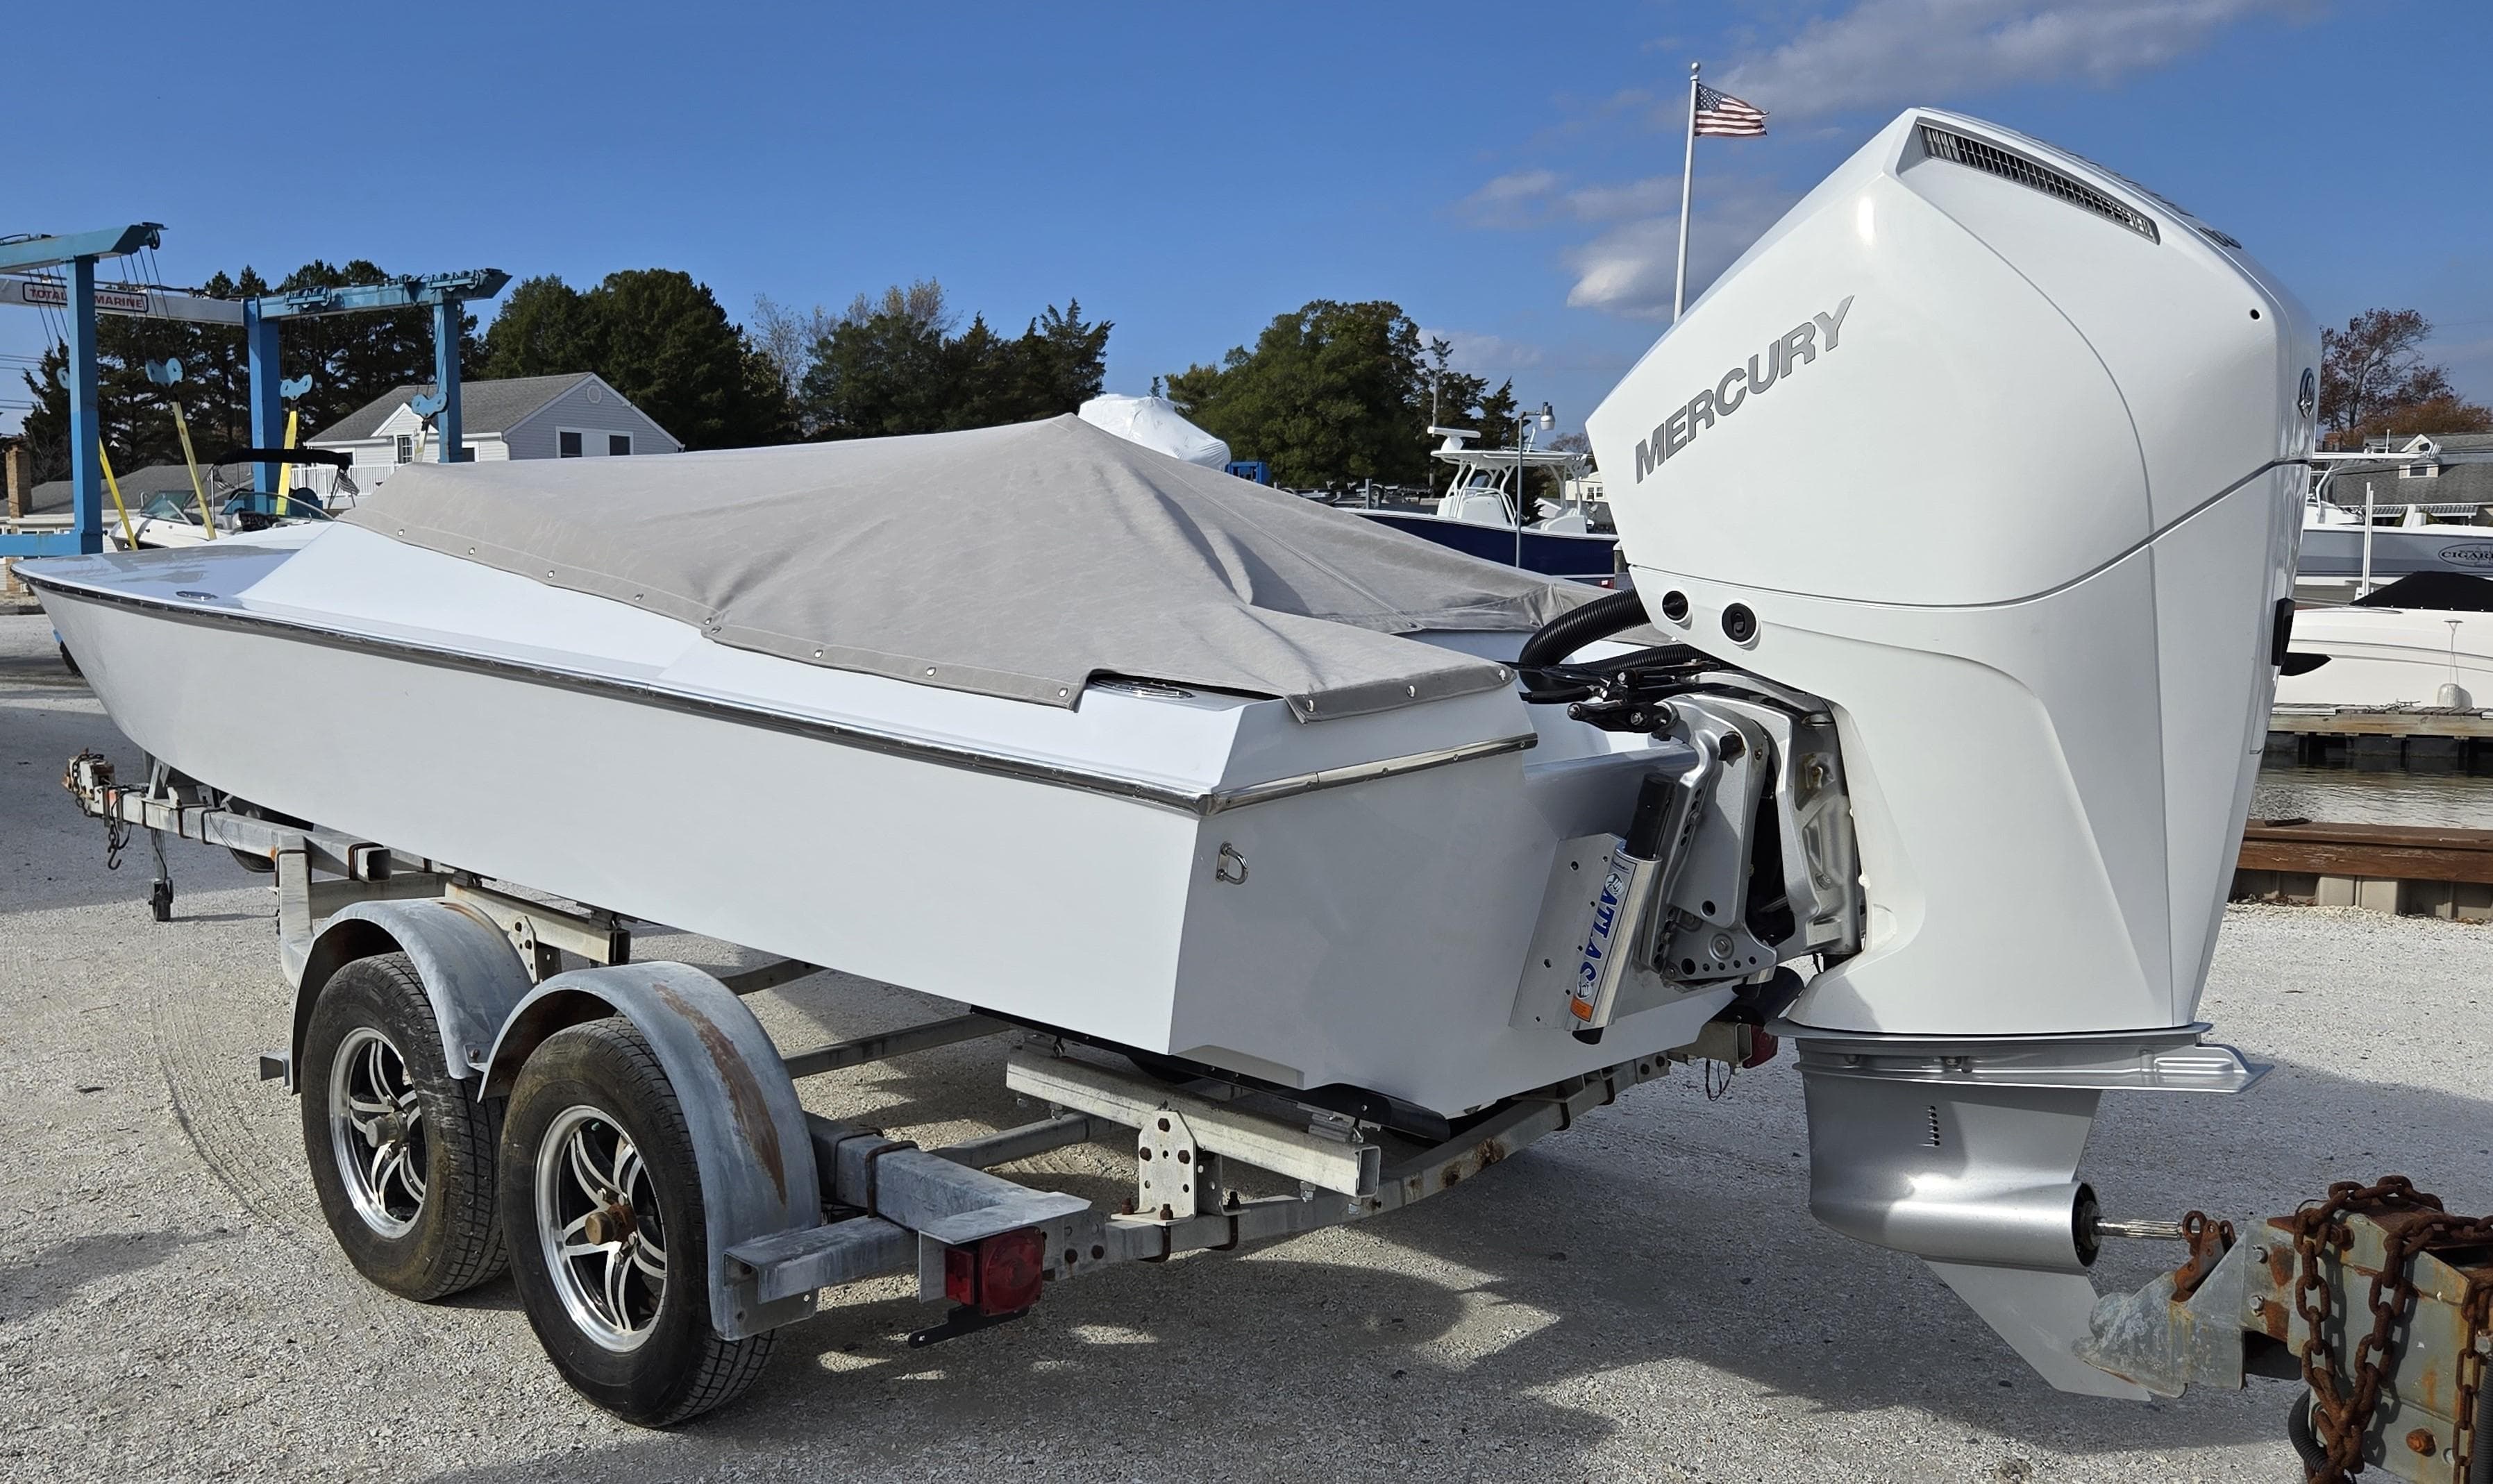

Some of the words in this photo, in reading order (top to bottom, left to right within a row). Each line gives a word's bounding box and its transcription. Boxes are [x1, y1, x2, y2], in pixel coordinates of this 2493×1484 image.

[30, 289, 67, 301] TOTAL
[94, 296, 142, 307] MARINE
[1636, 294, 1854, 484] MERCURY
